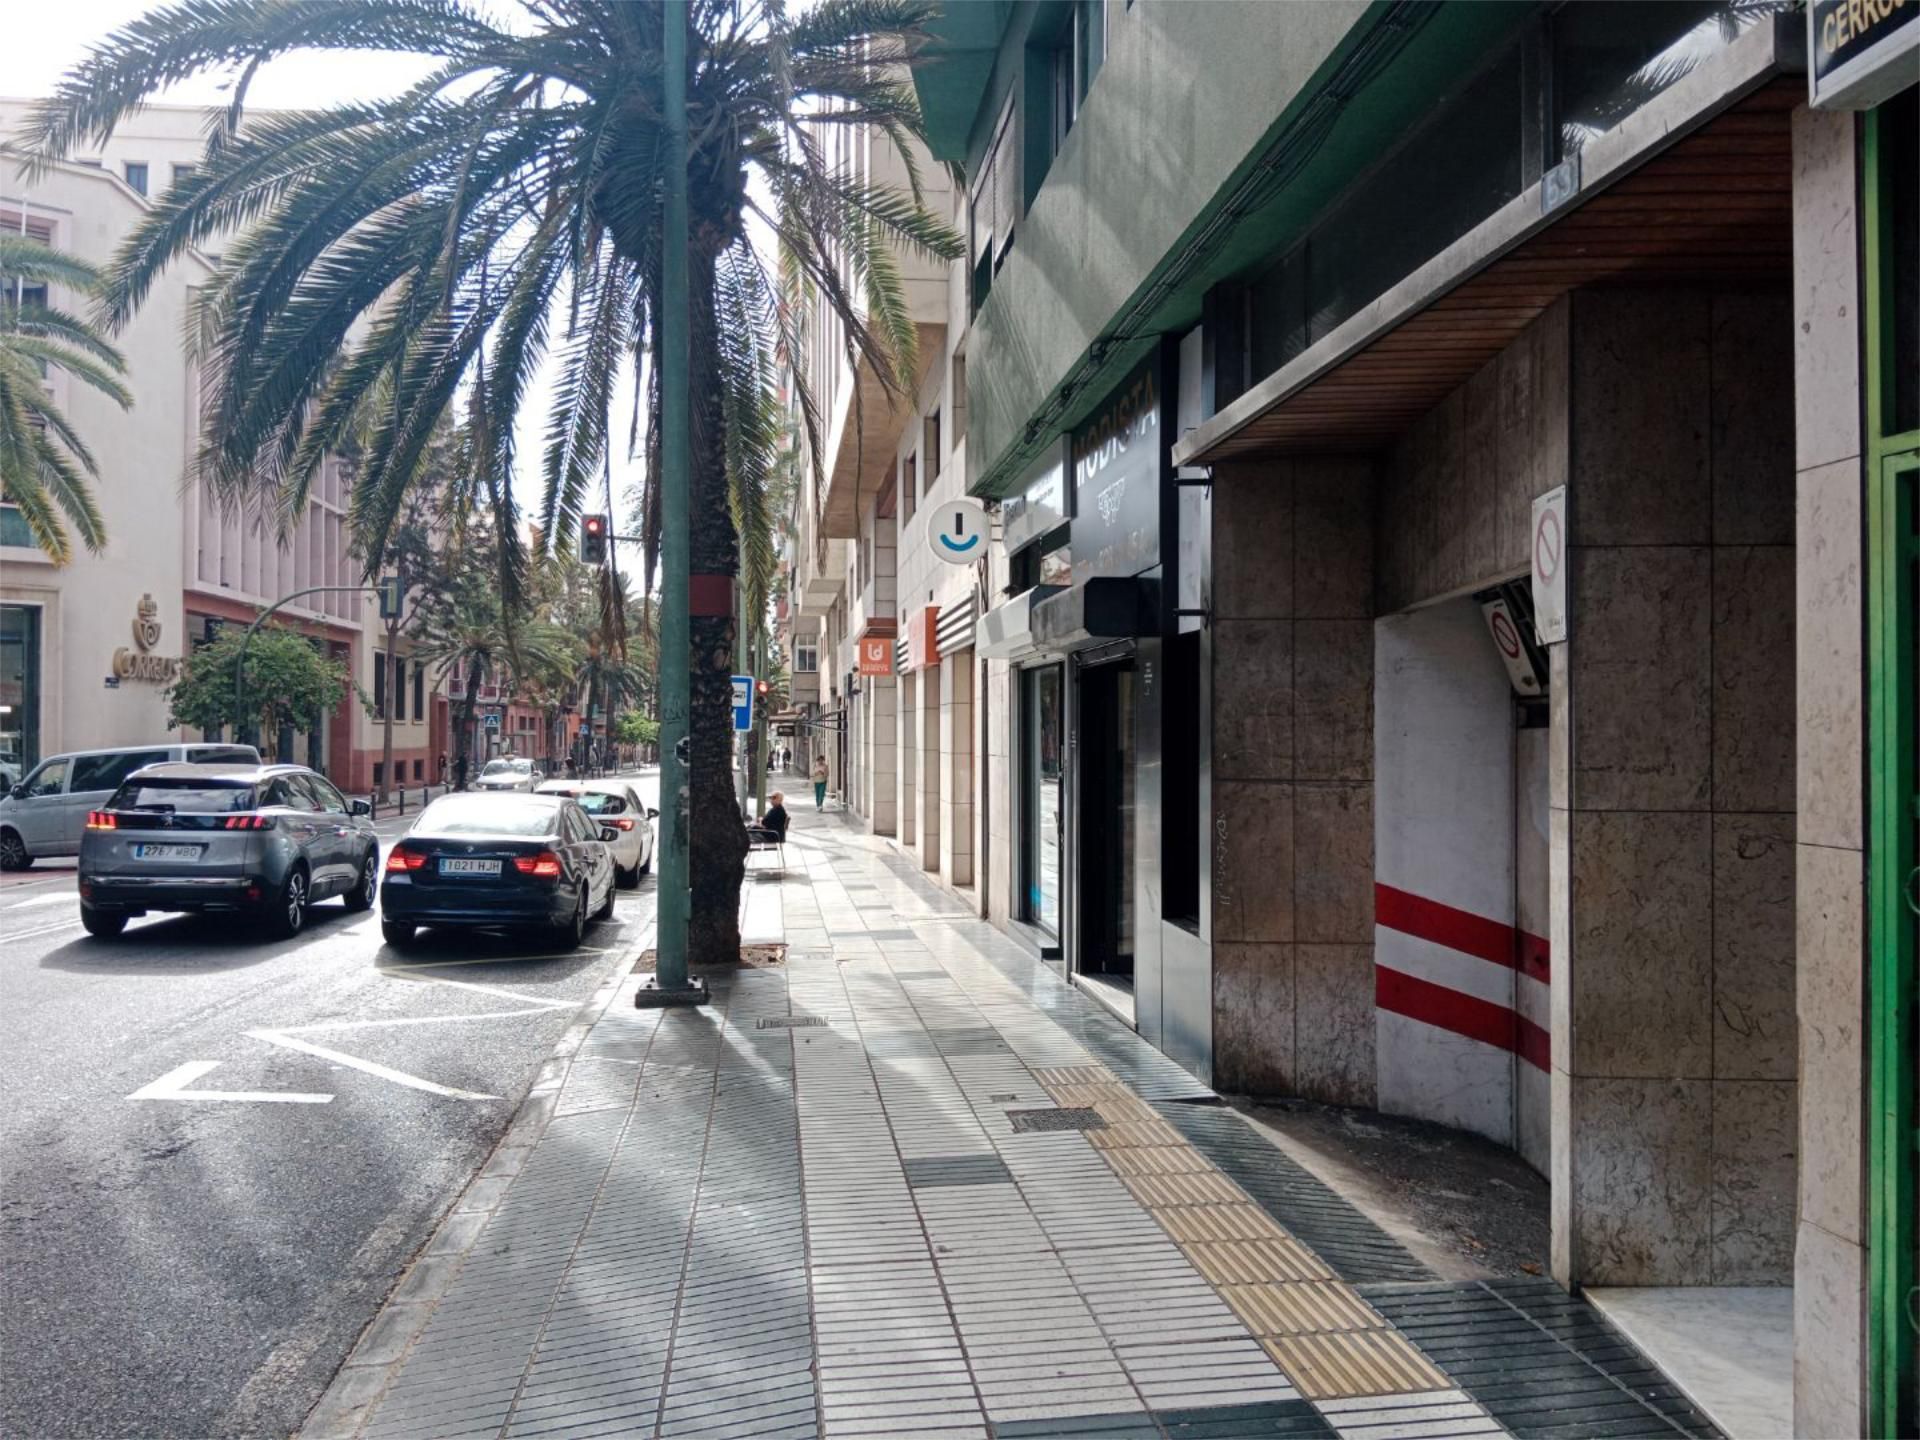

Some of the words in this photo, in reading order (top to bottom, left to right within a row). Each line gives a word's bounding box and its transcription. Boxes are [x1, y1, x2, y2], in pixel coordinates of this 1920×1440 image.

[1824, 0, 1905, 54] CERR
[1073, 368, 1156, 487] MODISTA
[448, 860, 473, 871] 1021
[478, 860, 500, 872] HJH
